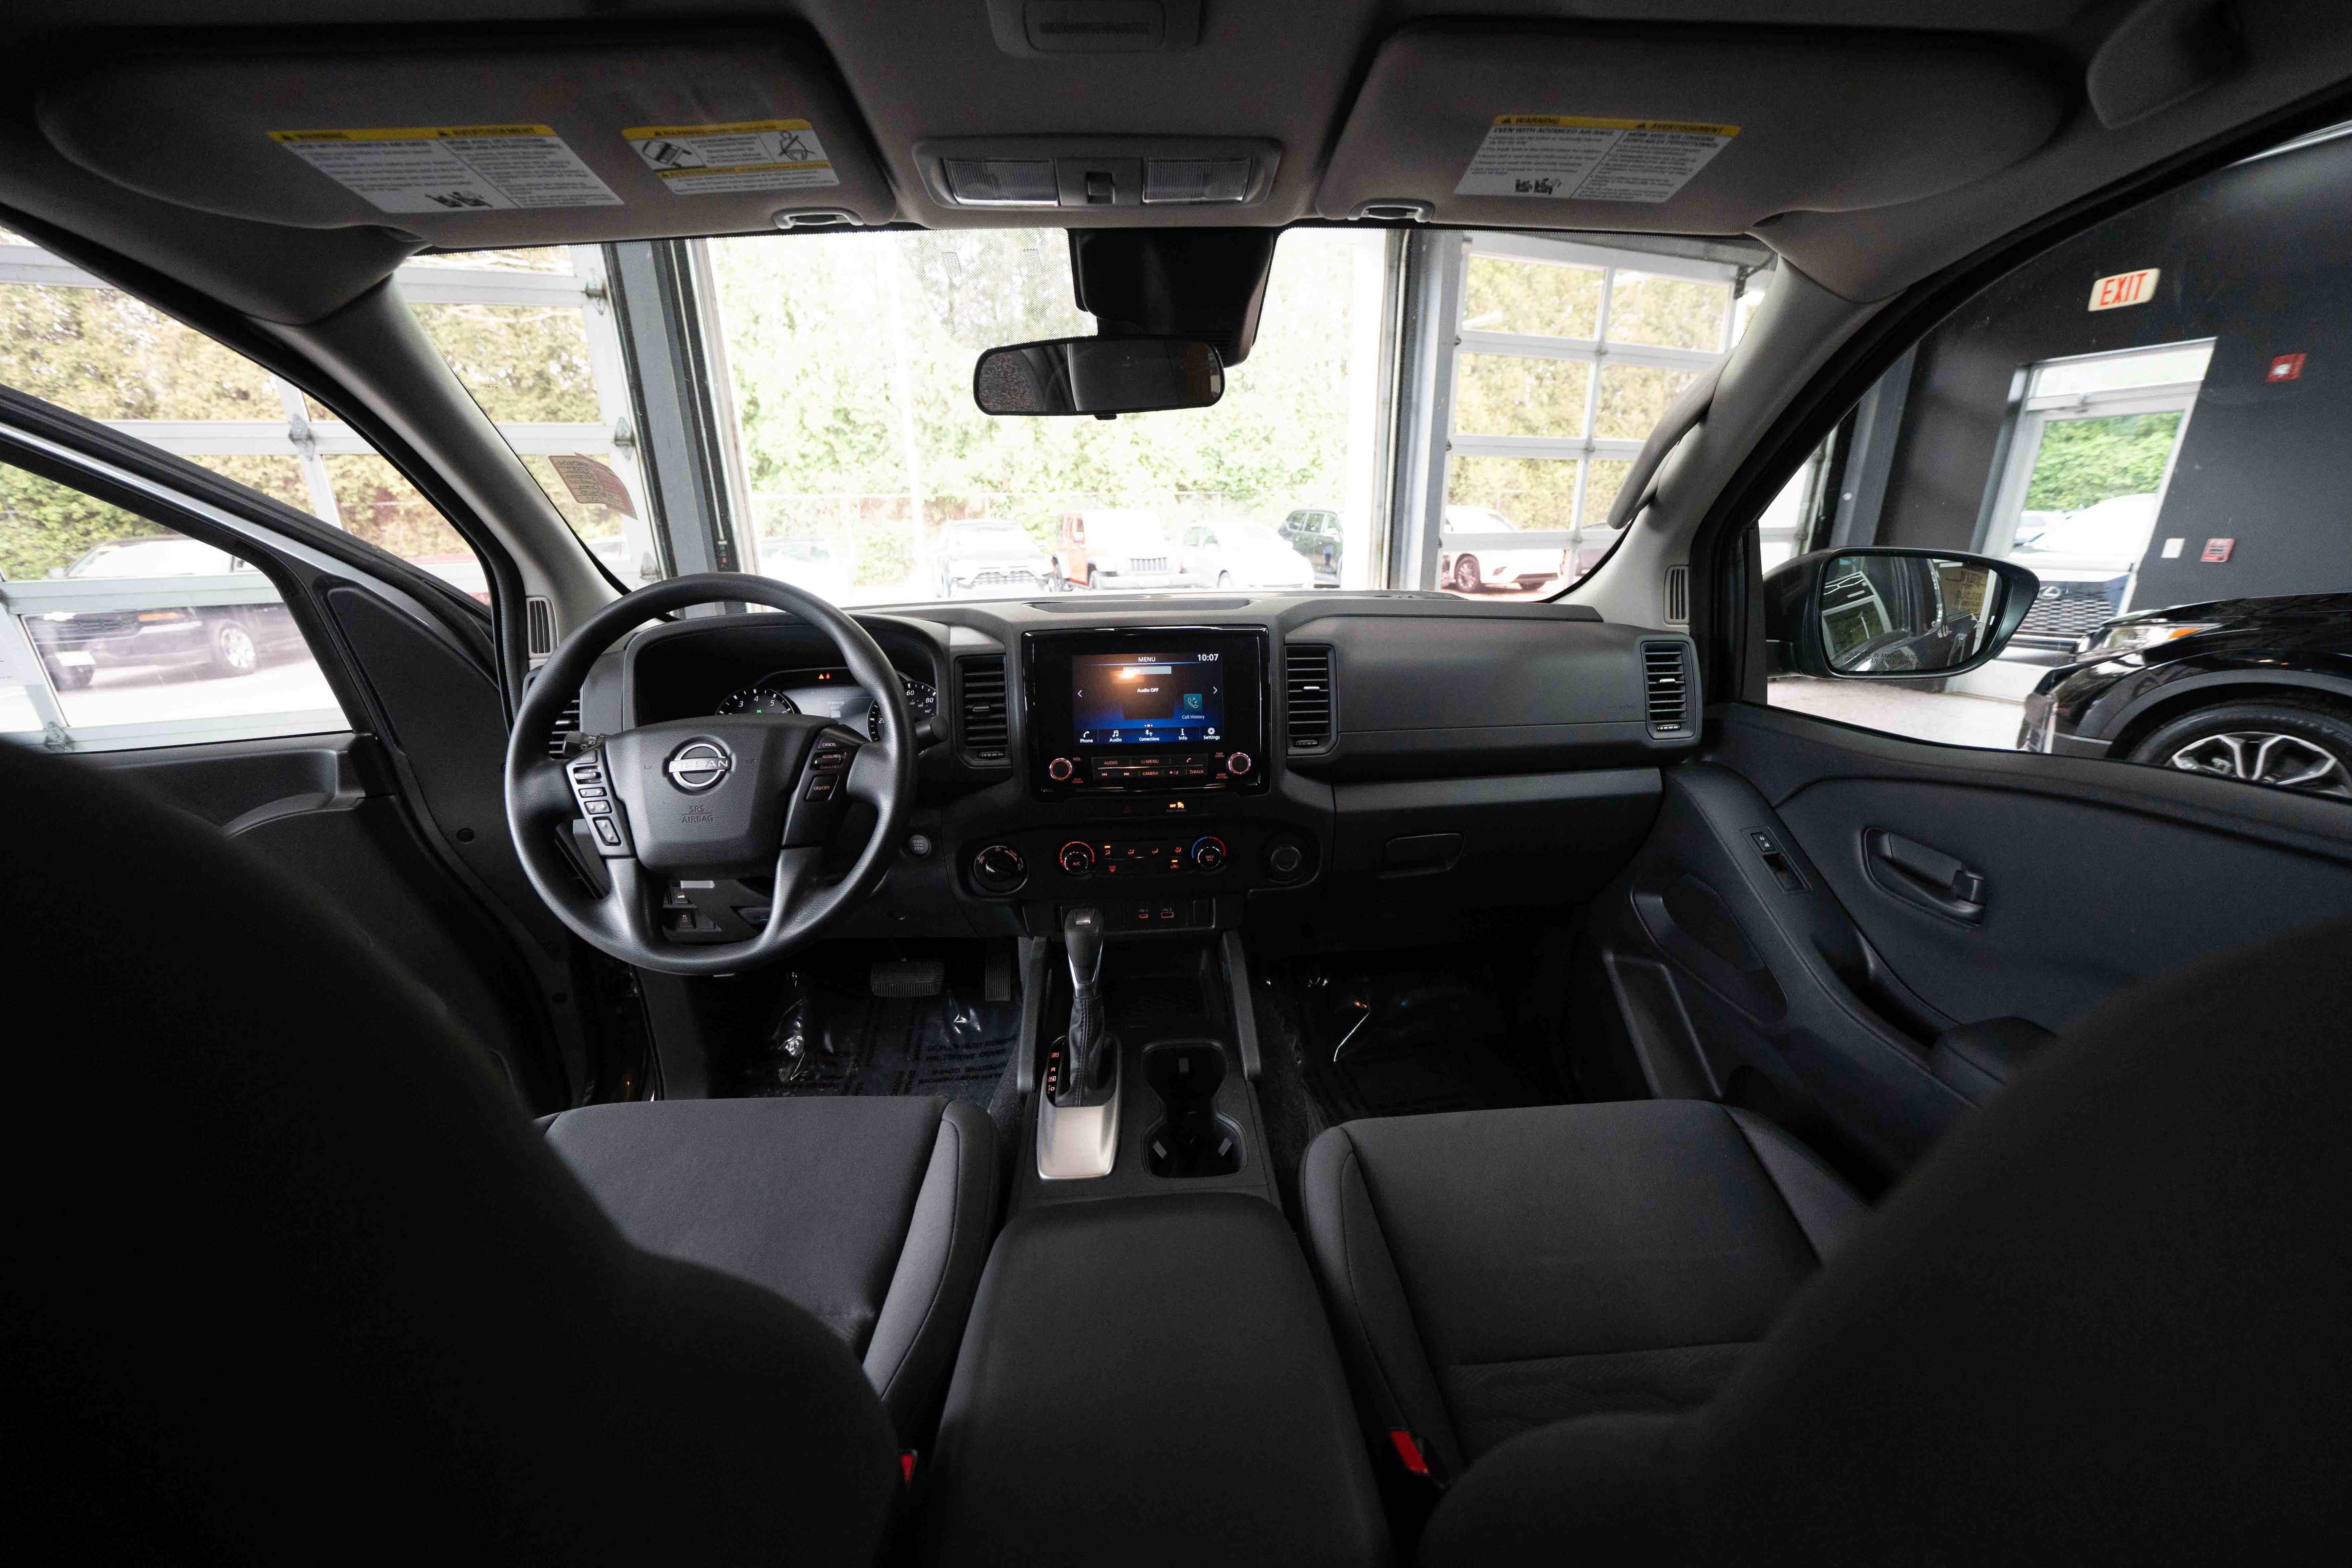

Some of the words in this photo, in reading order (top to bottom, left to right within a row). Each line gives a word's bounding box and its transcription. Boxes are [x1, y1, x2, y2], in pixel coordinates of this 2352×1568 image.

[2100, 272, 2148, 305] EXIT
[671, 760, 728, 770] NISSAN
[682, 814, 714, 824] AIRBAG
